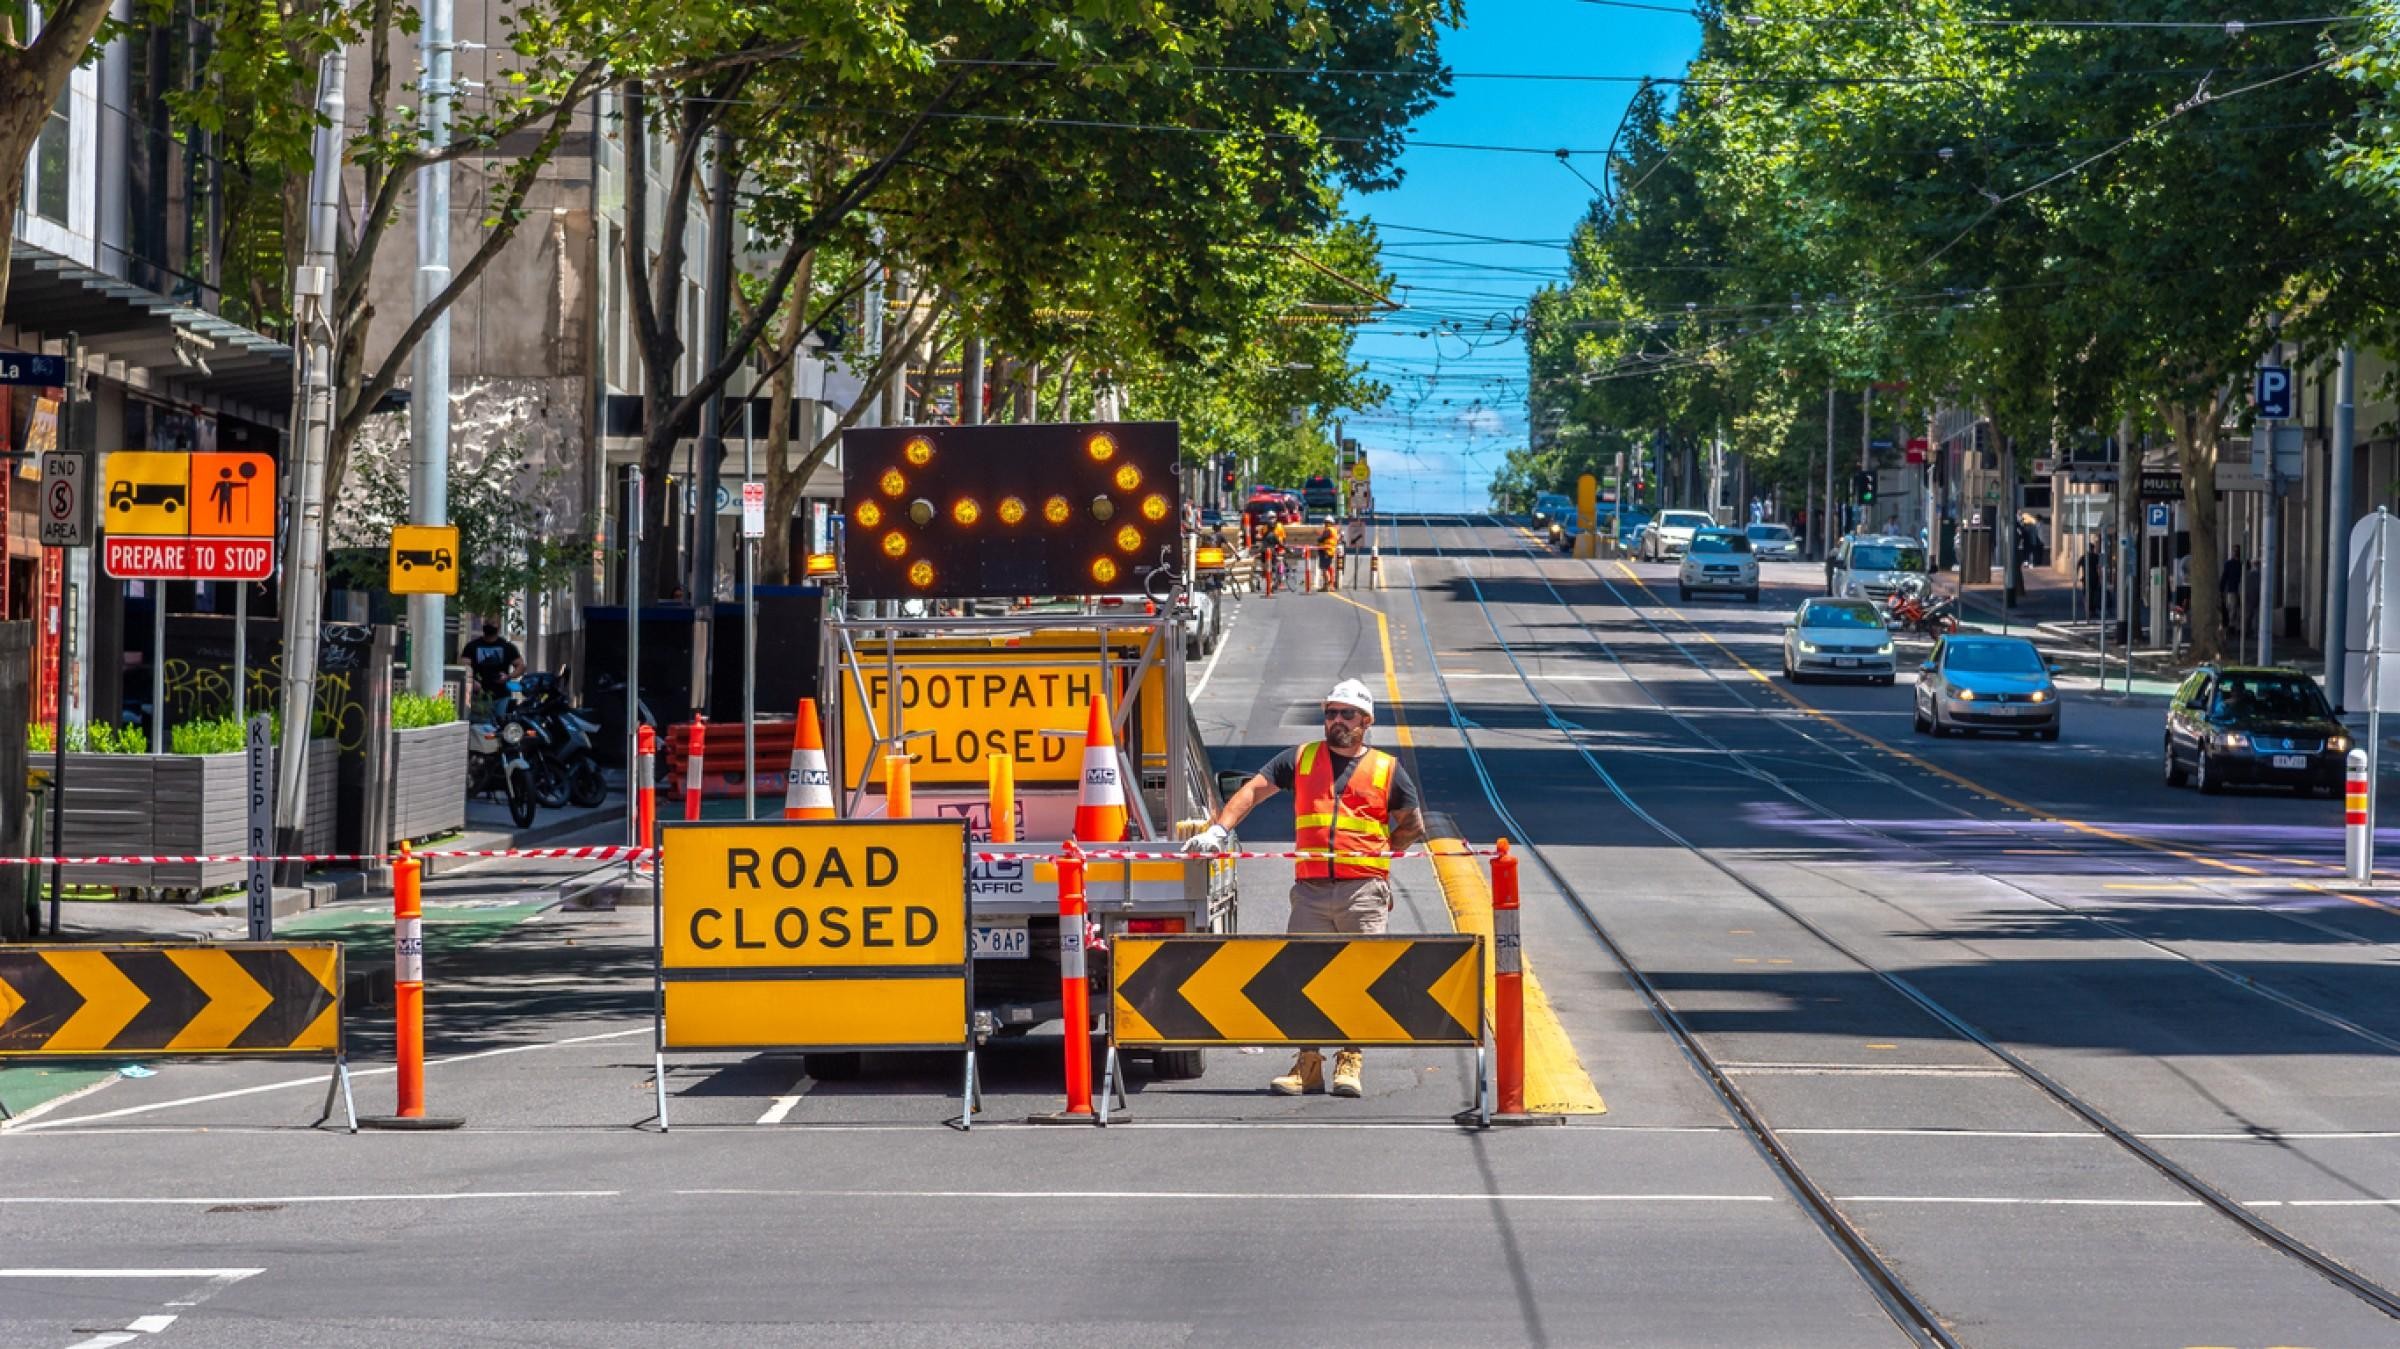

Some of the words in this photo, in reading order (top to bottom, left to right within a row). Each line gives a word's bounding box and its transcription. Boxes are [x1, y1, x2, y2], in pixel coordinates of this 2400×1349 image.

[2263, 372, 2286, 401] P
[49, 460, 76, 476] END
[44, 523, 77, 538] AREA
[2154, 509, 2163, 523] P
[111, 545, 185, 570] PREPARE
[195, 547, 215, 570] TO
[225, 547, 267, 572] STOP
[871, 673, 1091, 709] FOOTPATH
[902, 729, 1066, 764] CLOSED
[252, 721, 264, 813] KEEP
[727, 846, 899, 889] ROAD
[252, 828, 265, 941] RIGHT
[971, 882, 1023, 894] AFFIC
[690, 905, 938, 950] CLOSED
